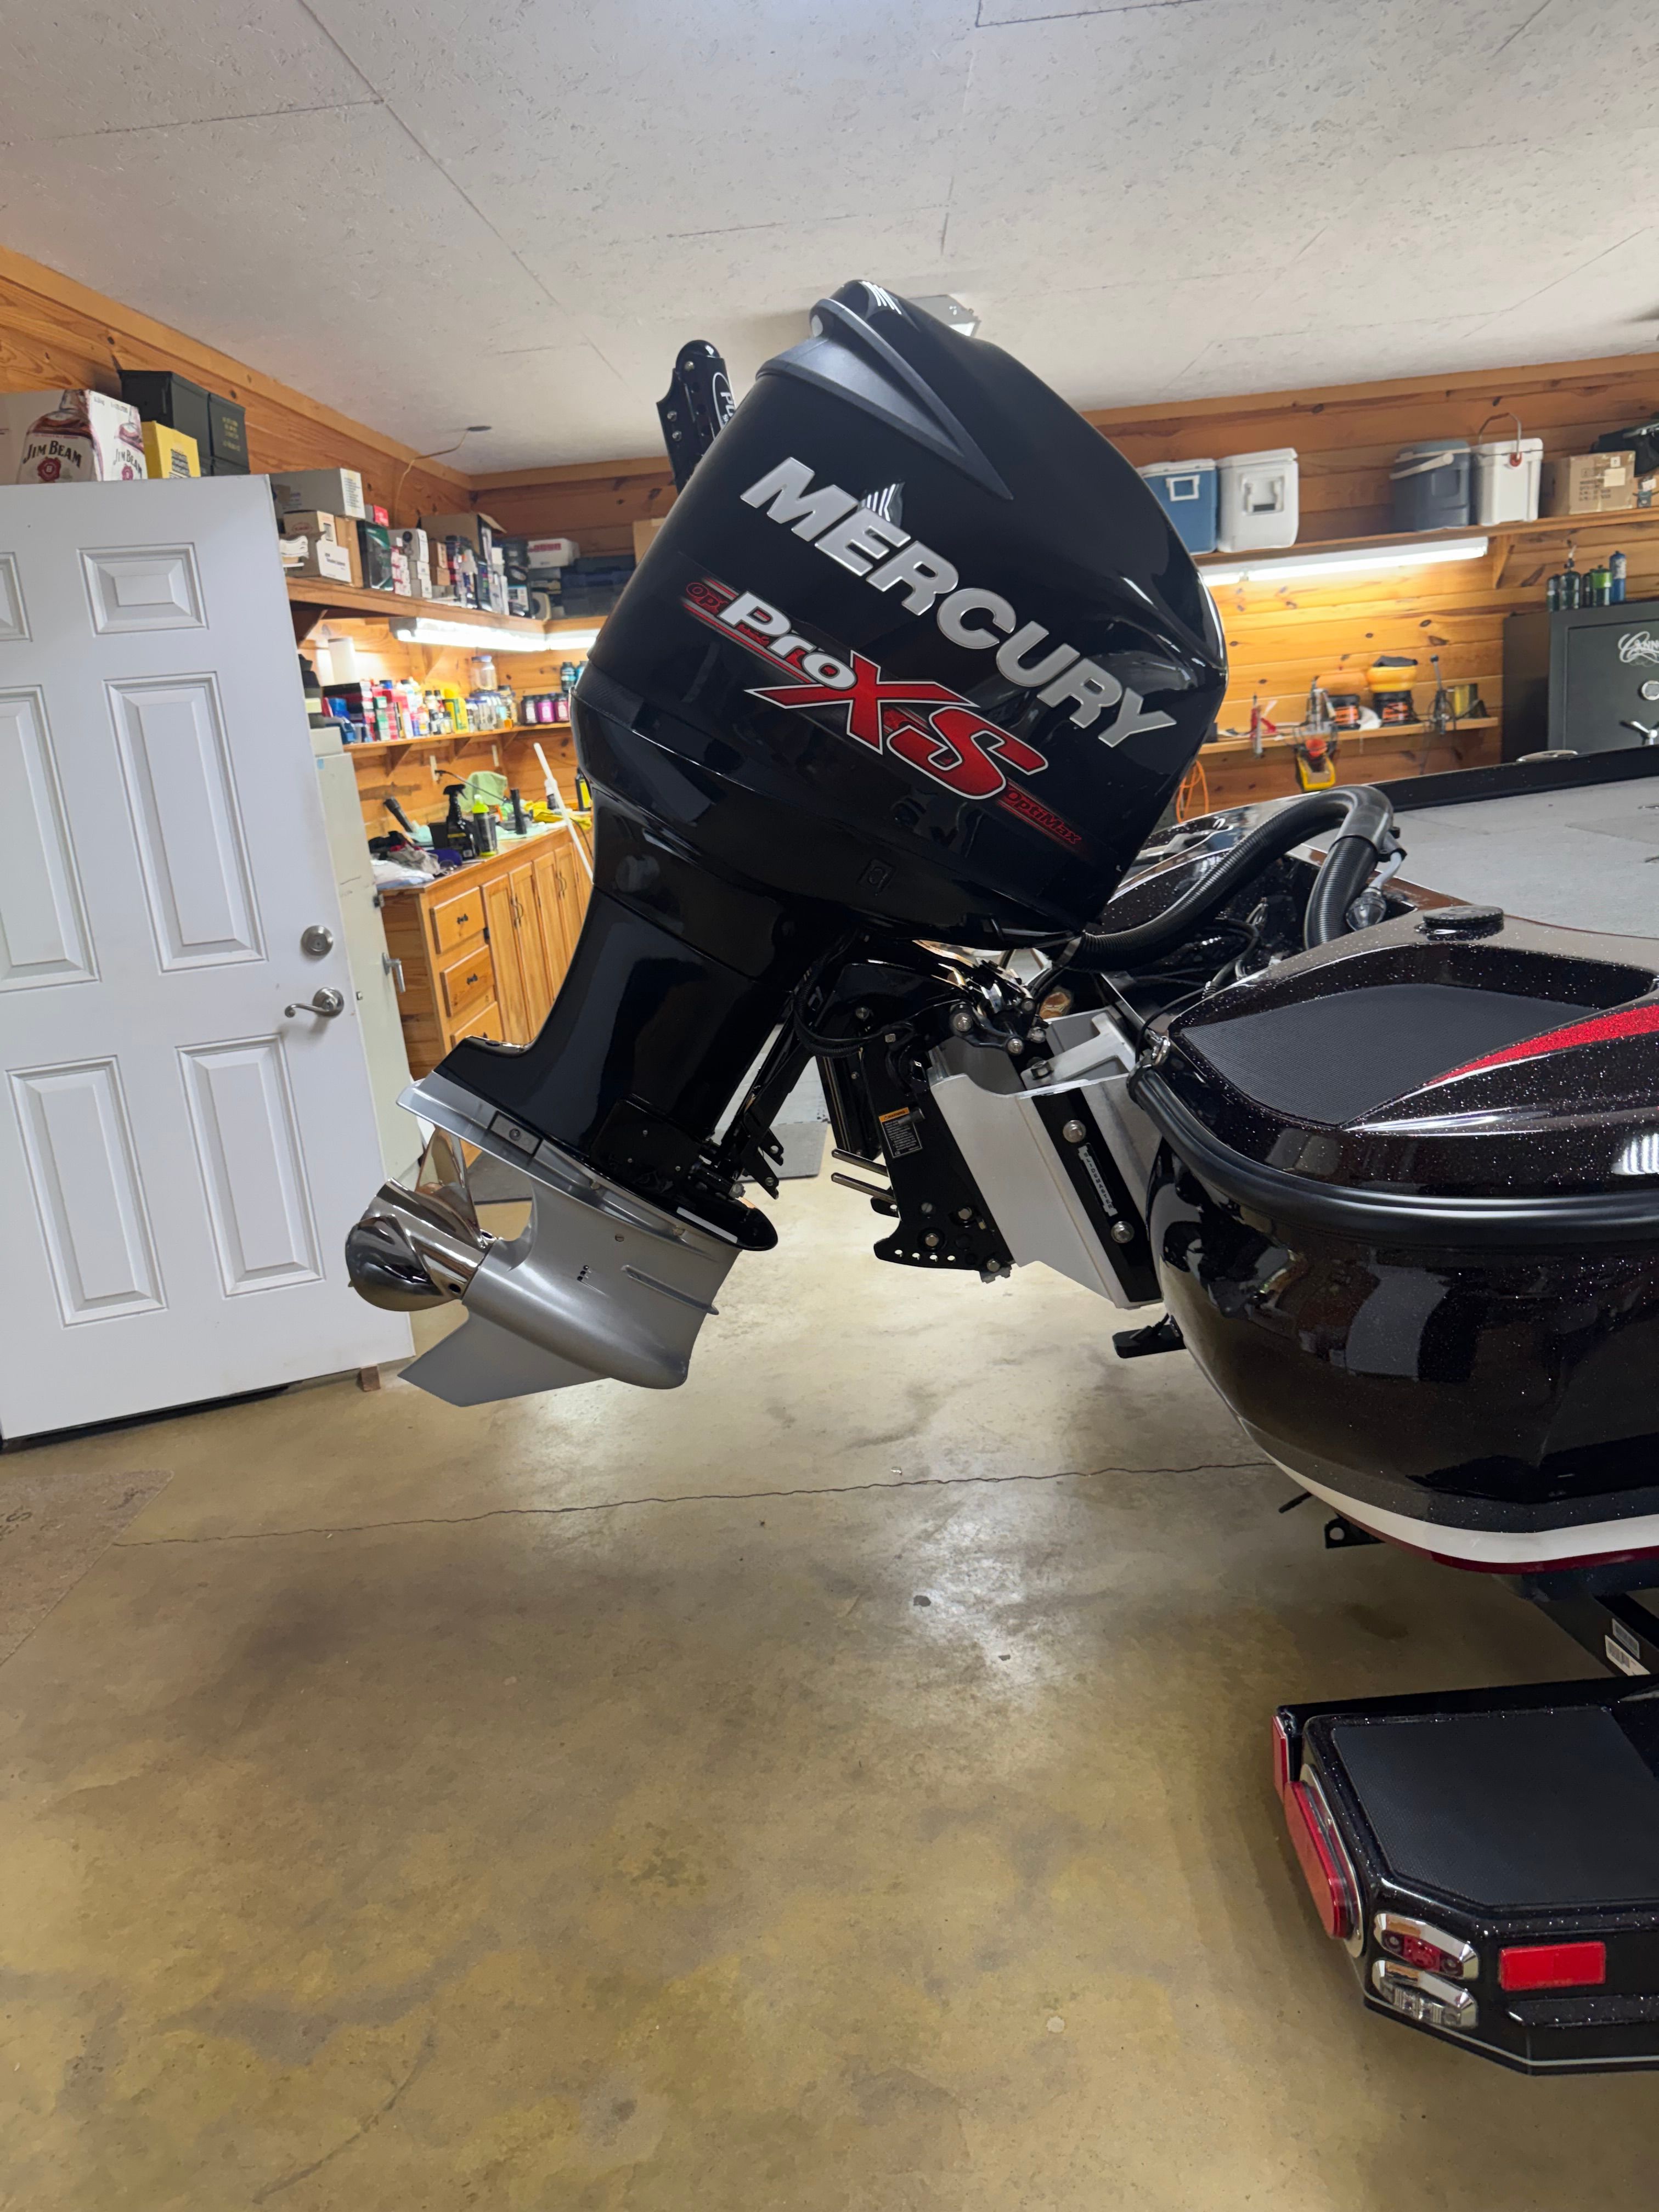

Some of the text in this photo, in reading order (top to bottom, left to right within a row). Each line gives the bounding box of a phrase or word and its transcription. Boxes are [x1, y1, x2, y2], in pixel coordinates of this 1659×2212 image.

[23, 440, 82, 468] JIM BEAM
[741, 457, 1177, 748] MERCURY
[1005, 789, 1082, 844] OptiMax
